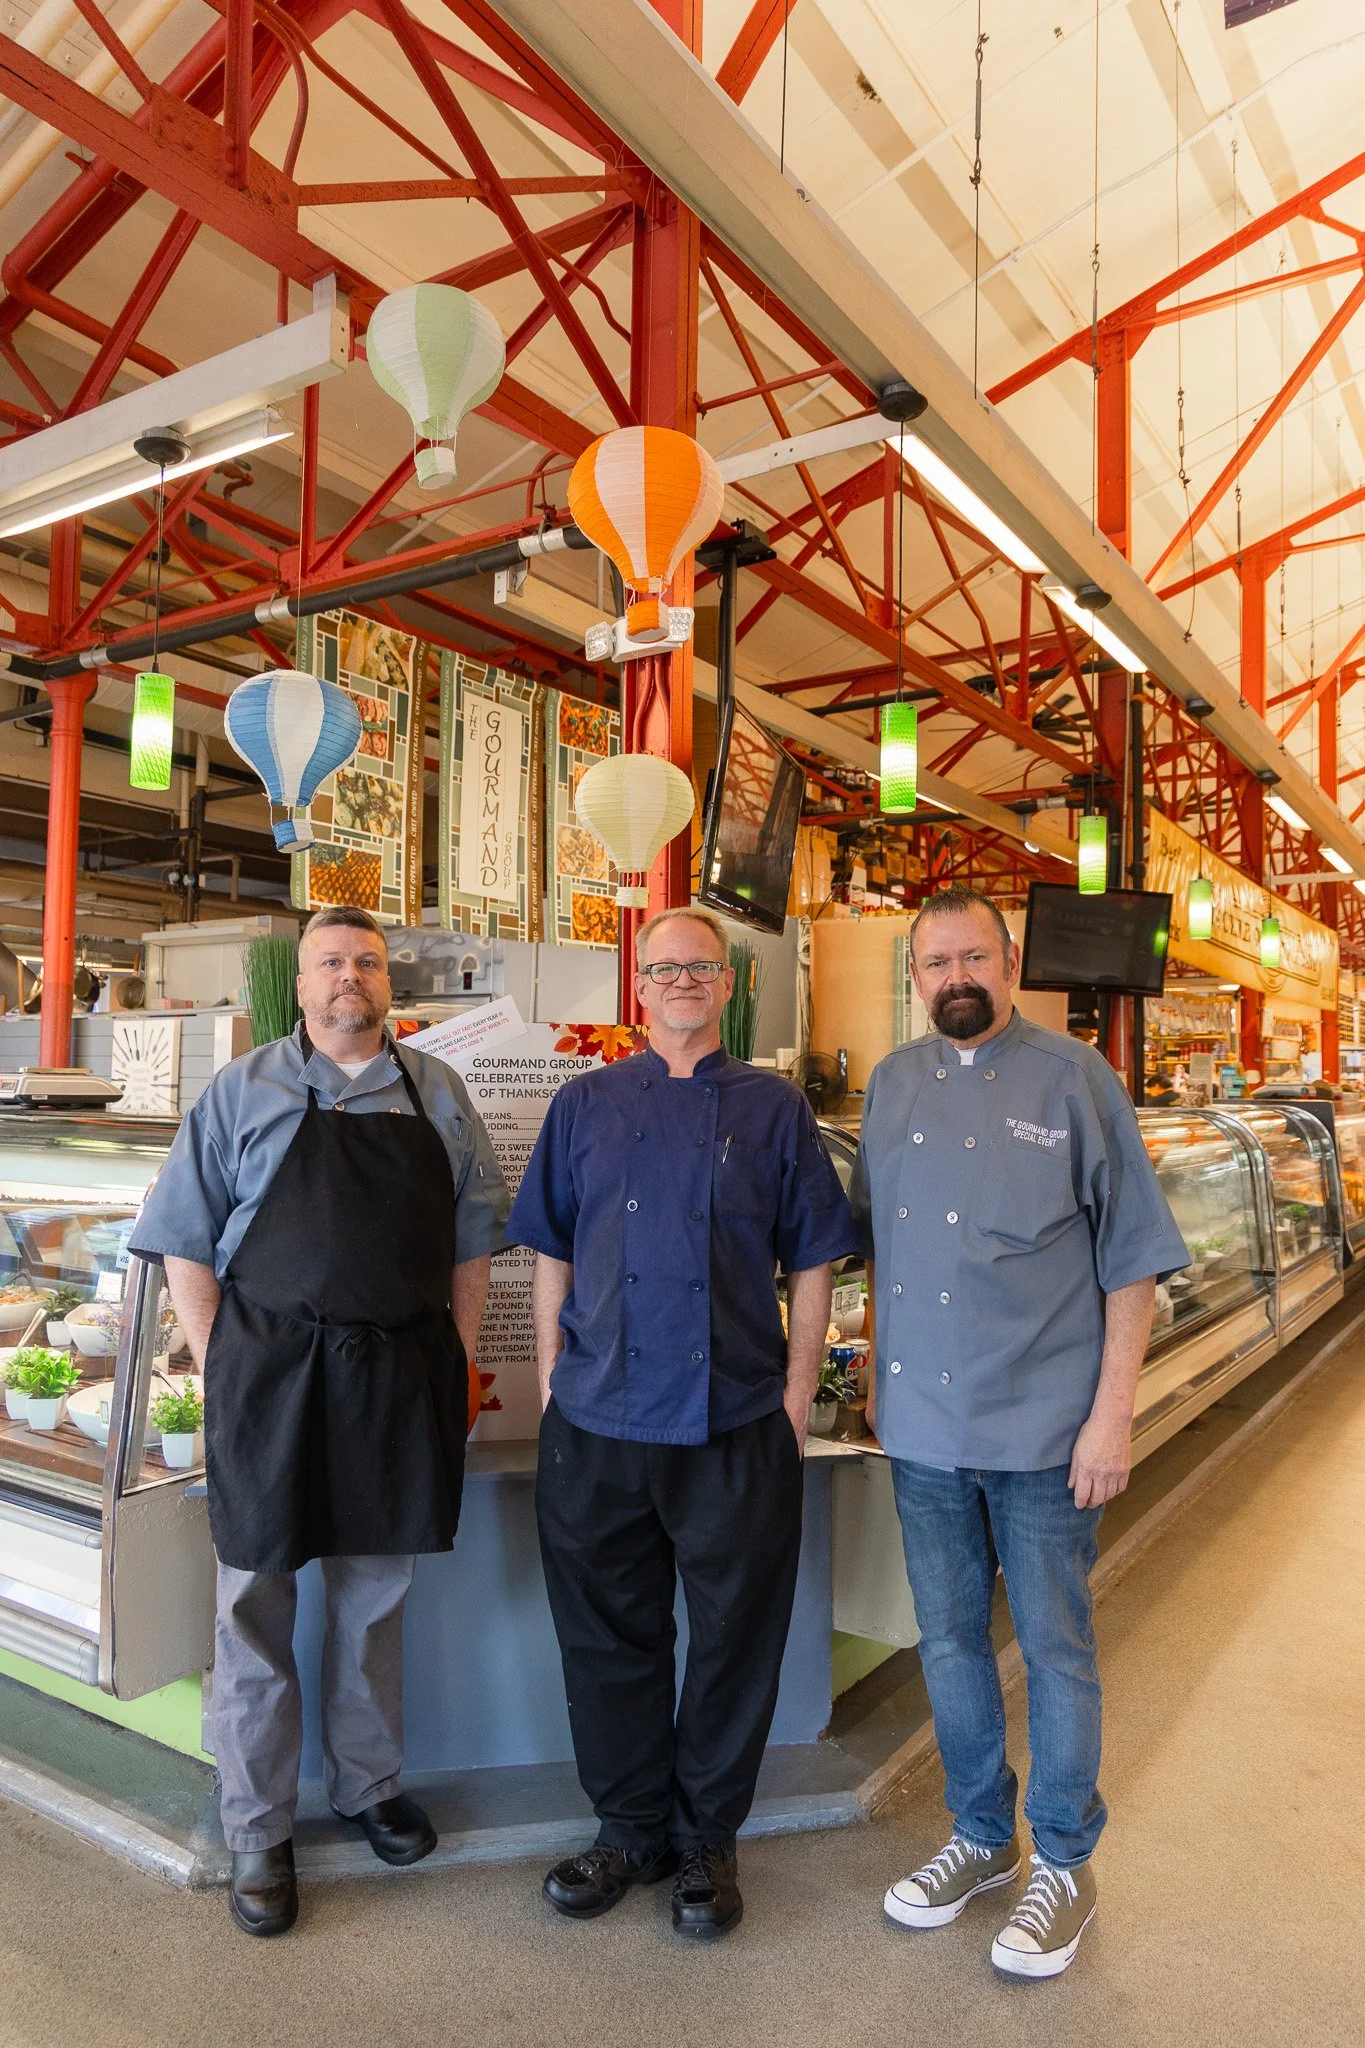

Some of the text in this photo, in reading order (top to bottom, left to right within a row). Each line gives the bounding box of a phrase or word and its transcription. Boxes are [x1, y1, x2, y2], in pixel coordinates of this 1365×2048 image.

[469, 703, 480, 741] THE
[480, 710, 501, 887] GOURMAND
[503, 832, 513, 890] GROUP
[473, 1058, 593, 1069] GOURMAND GROUP
[465, 1073, 544, 1084] CELEBRATES
[546, 1074, 560, 1084] 16
[478, 1088, 558, 1098] OF THANKS
[482, 1112, 512, 1120] BEANS
[486, 1123, 519, 1131] DDING
[1005, 1118, 1068, 1139] THE GOURMAND GROUP
[1012, 1128, 1057, 1148] SPECIAL EVENT
[509, 1154, 531, 1162] SALA
[500, 1164, 528, 1172] ROUT
[490, 1259, 521, 1267] ASTED
[491, 1302, 524, 1310] POUND
[499, 1323, 509, 1331] IN
[511, 1323, 535, 1331] TURK
[477, 1334, 509, 1343] RDERS
[476, 1345, 489, 1353] UP
[490, 1344, 530, 1353] TUESDAY
[505, 1354, 530, 1363] FROM
